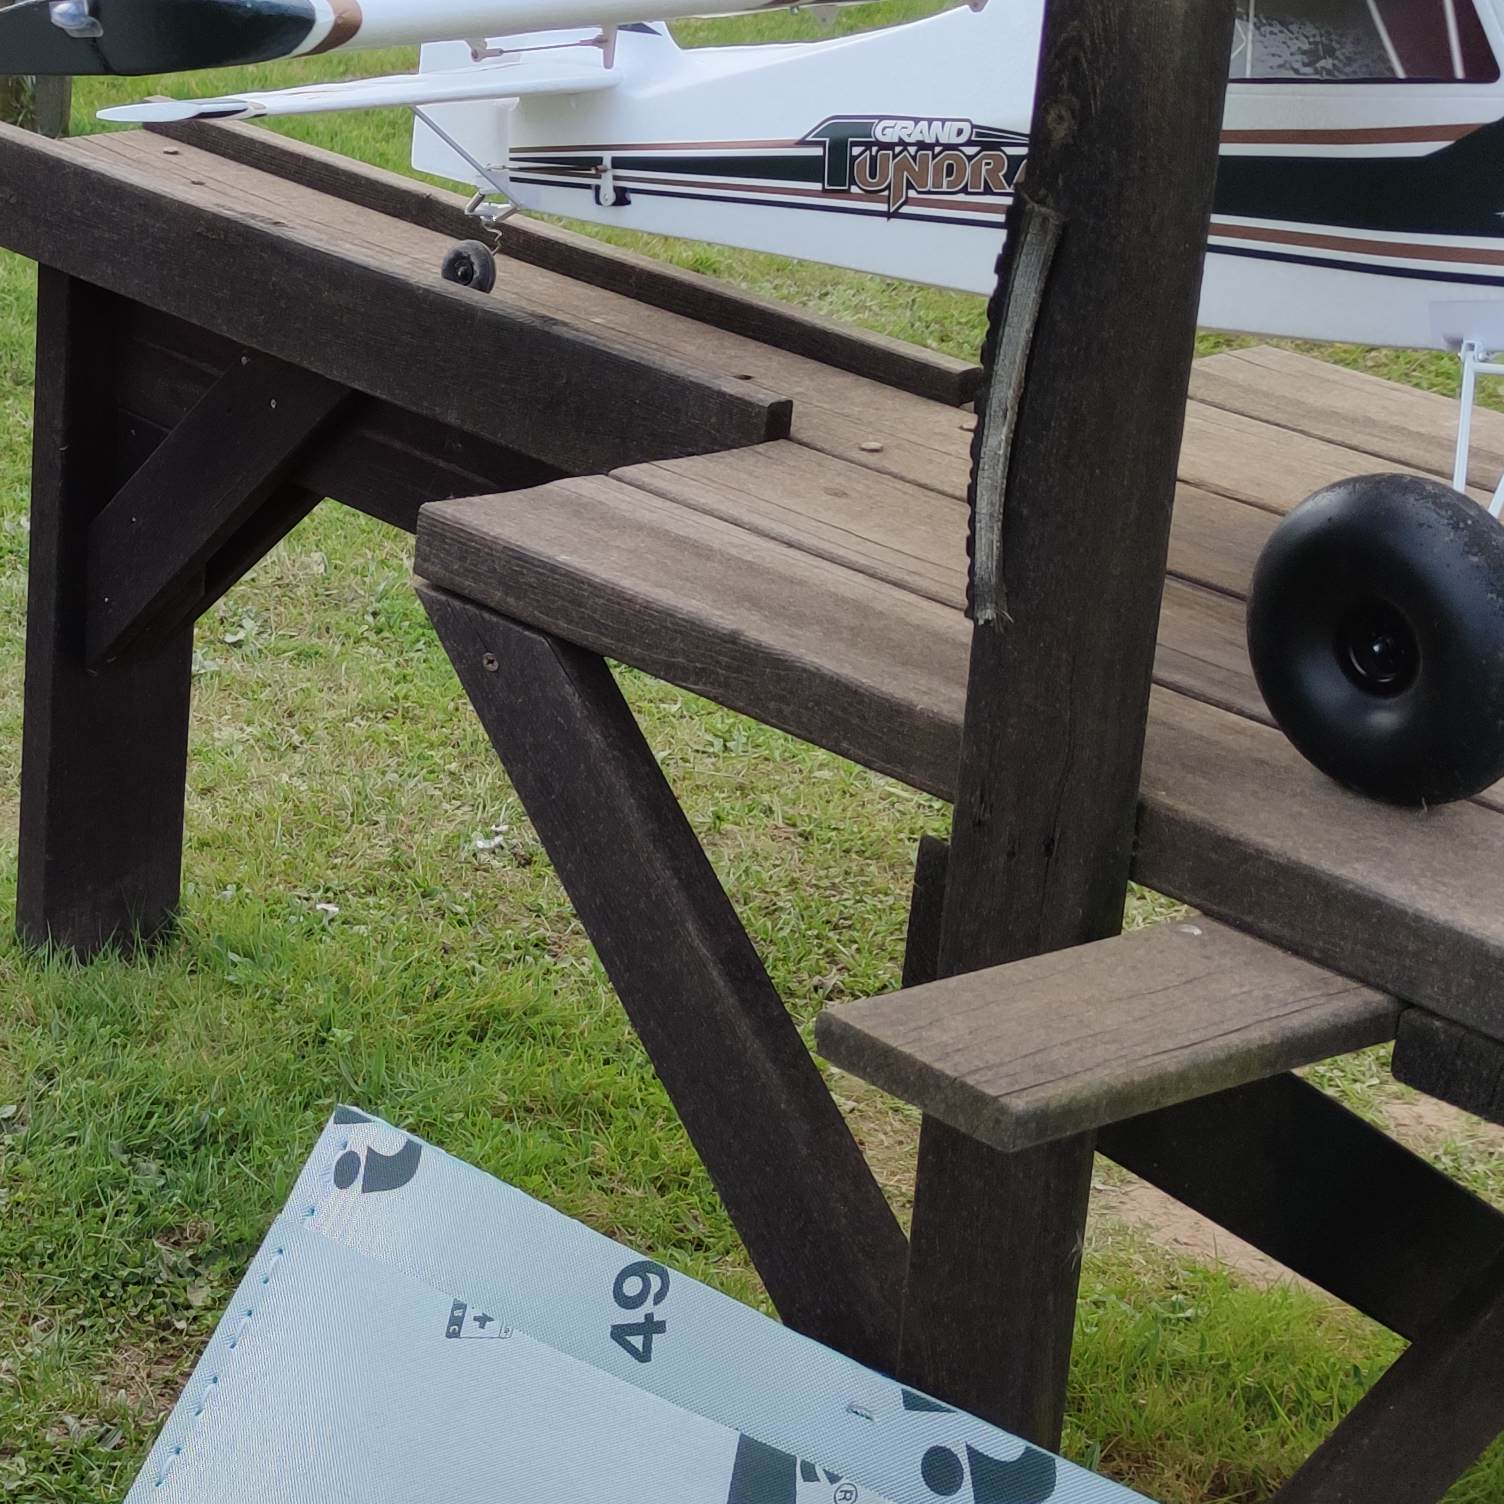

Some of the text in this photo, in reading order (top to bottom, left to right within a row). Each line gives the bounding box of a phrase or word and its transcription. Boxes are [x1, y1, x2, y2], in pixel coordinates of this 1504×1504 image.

[806, 120, 1029, 213] TUNDR
[874, 120, 972, 144] GRAND
[610, 1260, 670, 1363] 49
